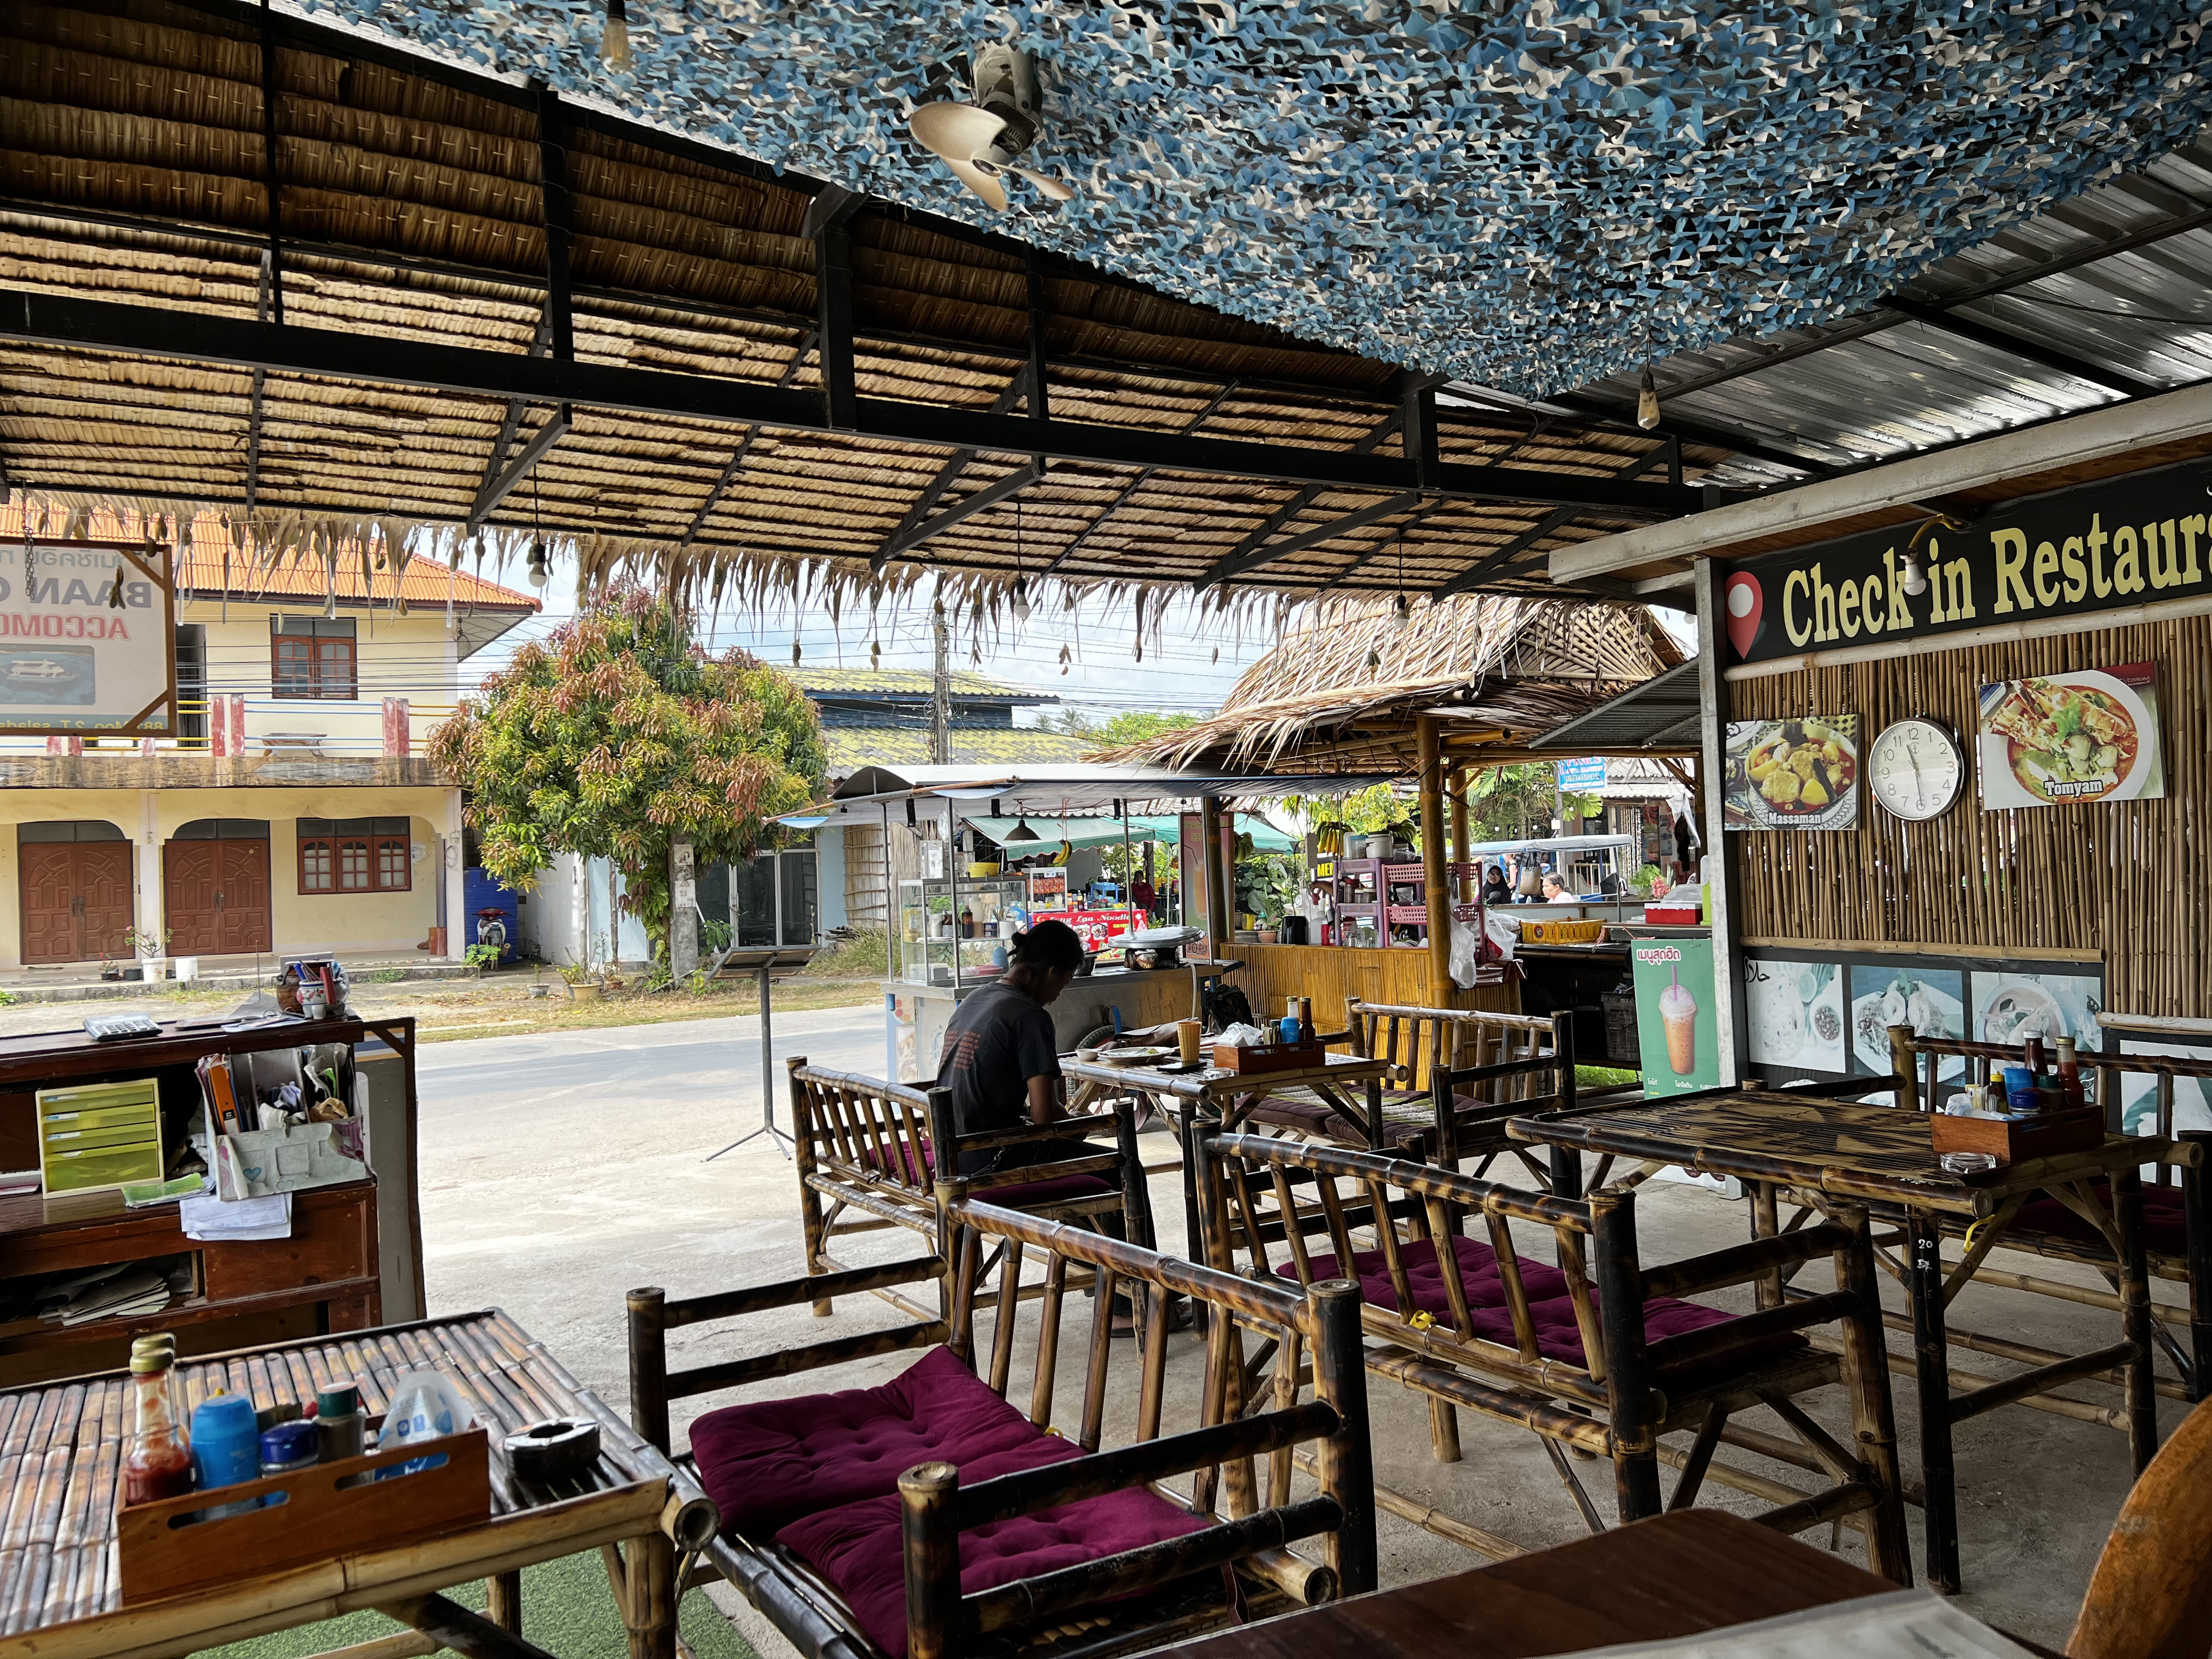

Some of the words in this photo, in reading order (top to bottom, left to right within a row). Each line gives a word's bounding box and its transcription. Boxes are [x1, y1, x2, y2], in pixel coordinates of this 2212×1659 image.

[1783, 546, 1913, 647] Check
[1928, 538, 1976, 624] in
[1990, 513, 2212, 614] Restaur
[1907, 728, 1919, 740] 12
[1928, 731, 1932, 743] 1
[1893, 735, 1902, 747] 11
[1939, 743, 1948, 754] 2
[1883, 749, 1895, 761] 10
[1881, 767, 1890, 779] 9
[1946, 761, 1955, 773] 3
[1887, 783, 1896, 796] 8
[1942, 779, 1951, 791] 4
[2044, 780, 2103, 797] Tomyam
[1901, 796, 1908, 807] 7
[1916, 799, 1925, 811] 6
[1932, 794, 1940, 806] 5
[1768, 812, 1822, 825] Massaman
[1317, 862, 1333, 877] MEN
[1744, 957, 1770, 983] حلال
[1918, 1239, 1933, 1249] 20
